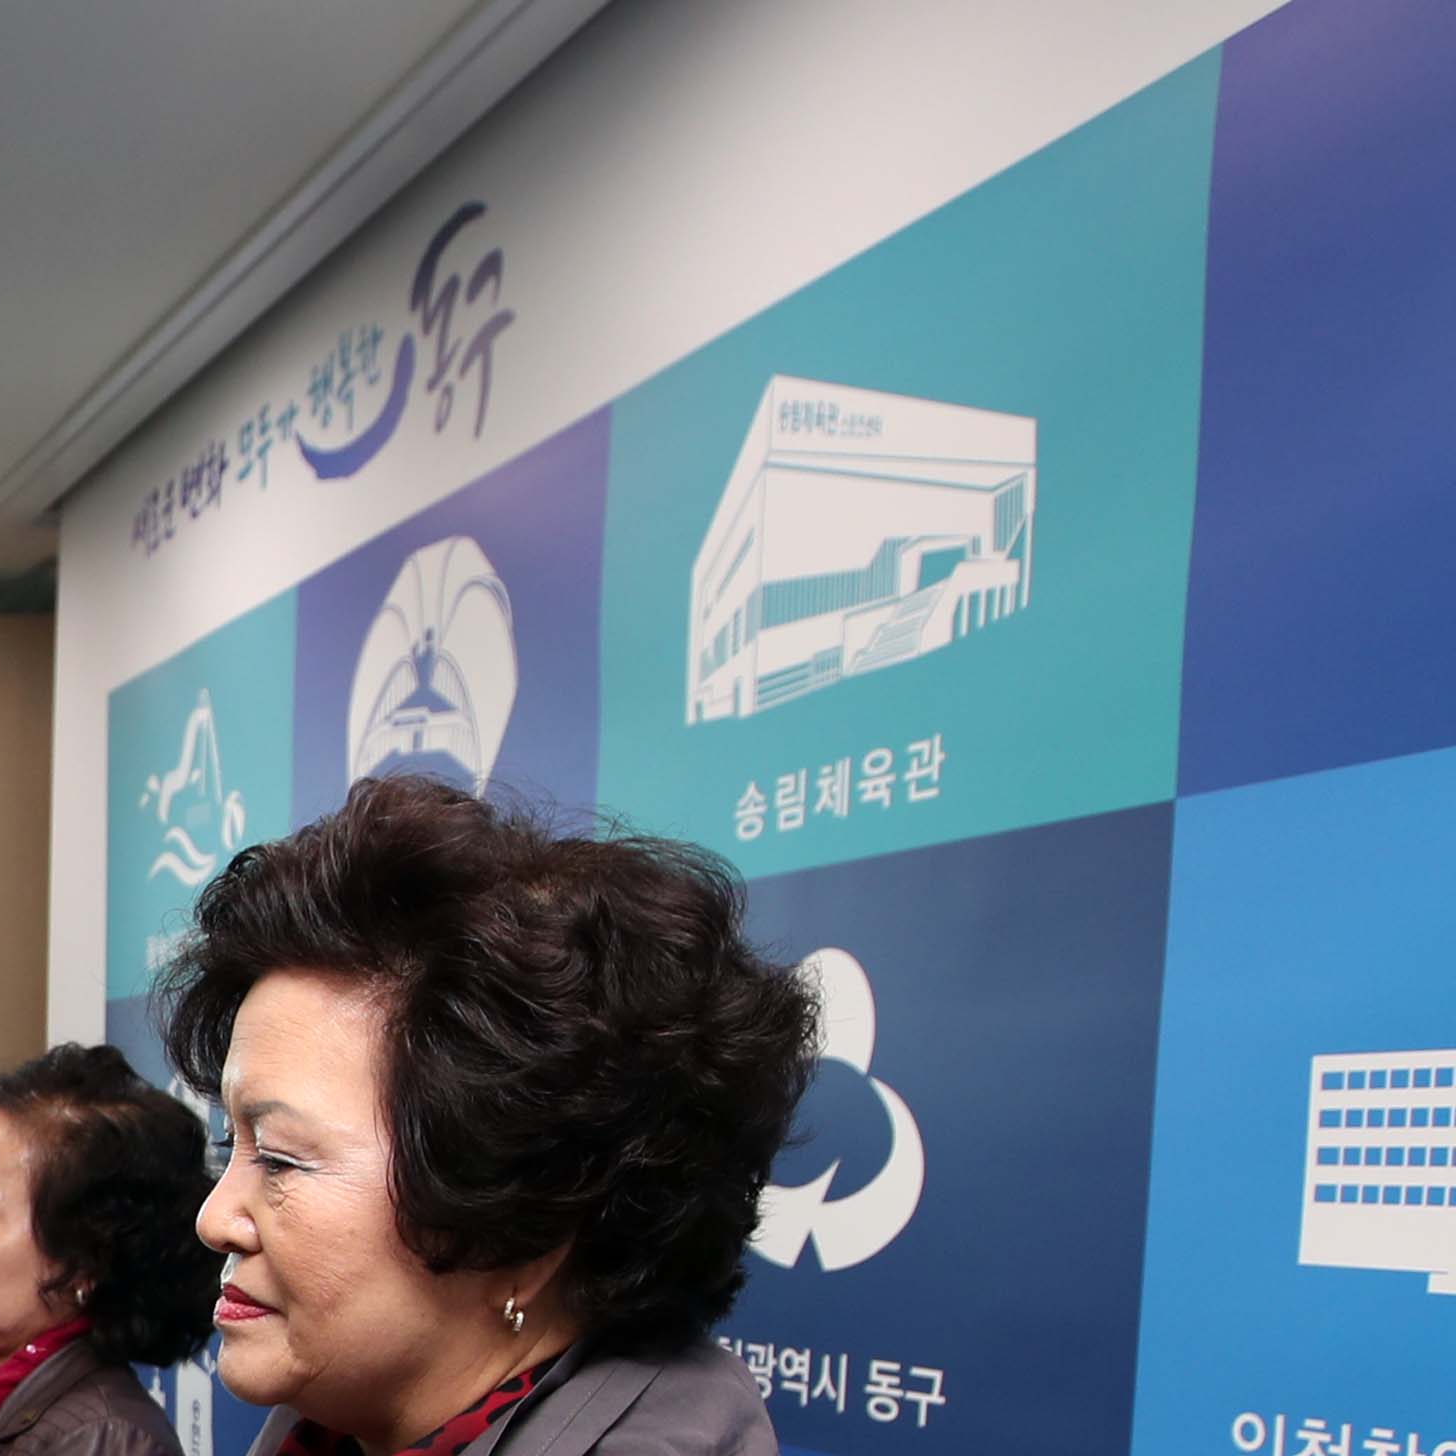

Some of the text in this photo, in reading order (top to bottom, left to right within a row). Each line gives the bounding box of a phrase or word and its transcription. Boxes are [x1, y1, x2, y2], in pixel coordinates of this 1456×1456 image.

[733, 732, 945, 841] 송림체육관
[717, 1335, 947, 1428] 광역시 동구
